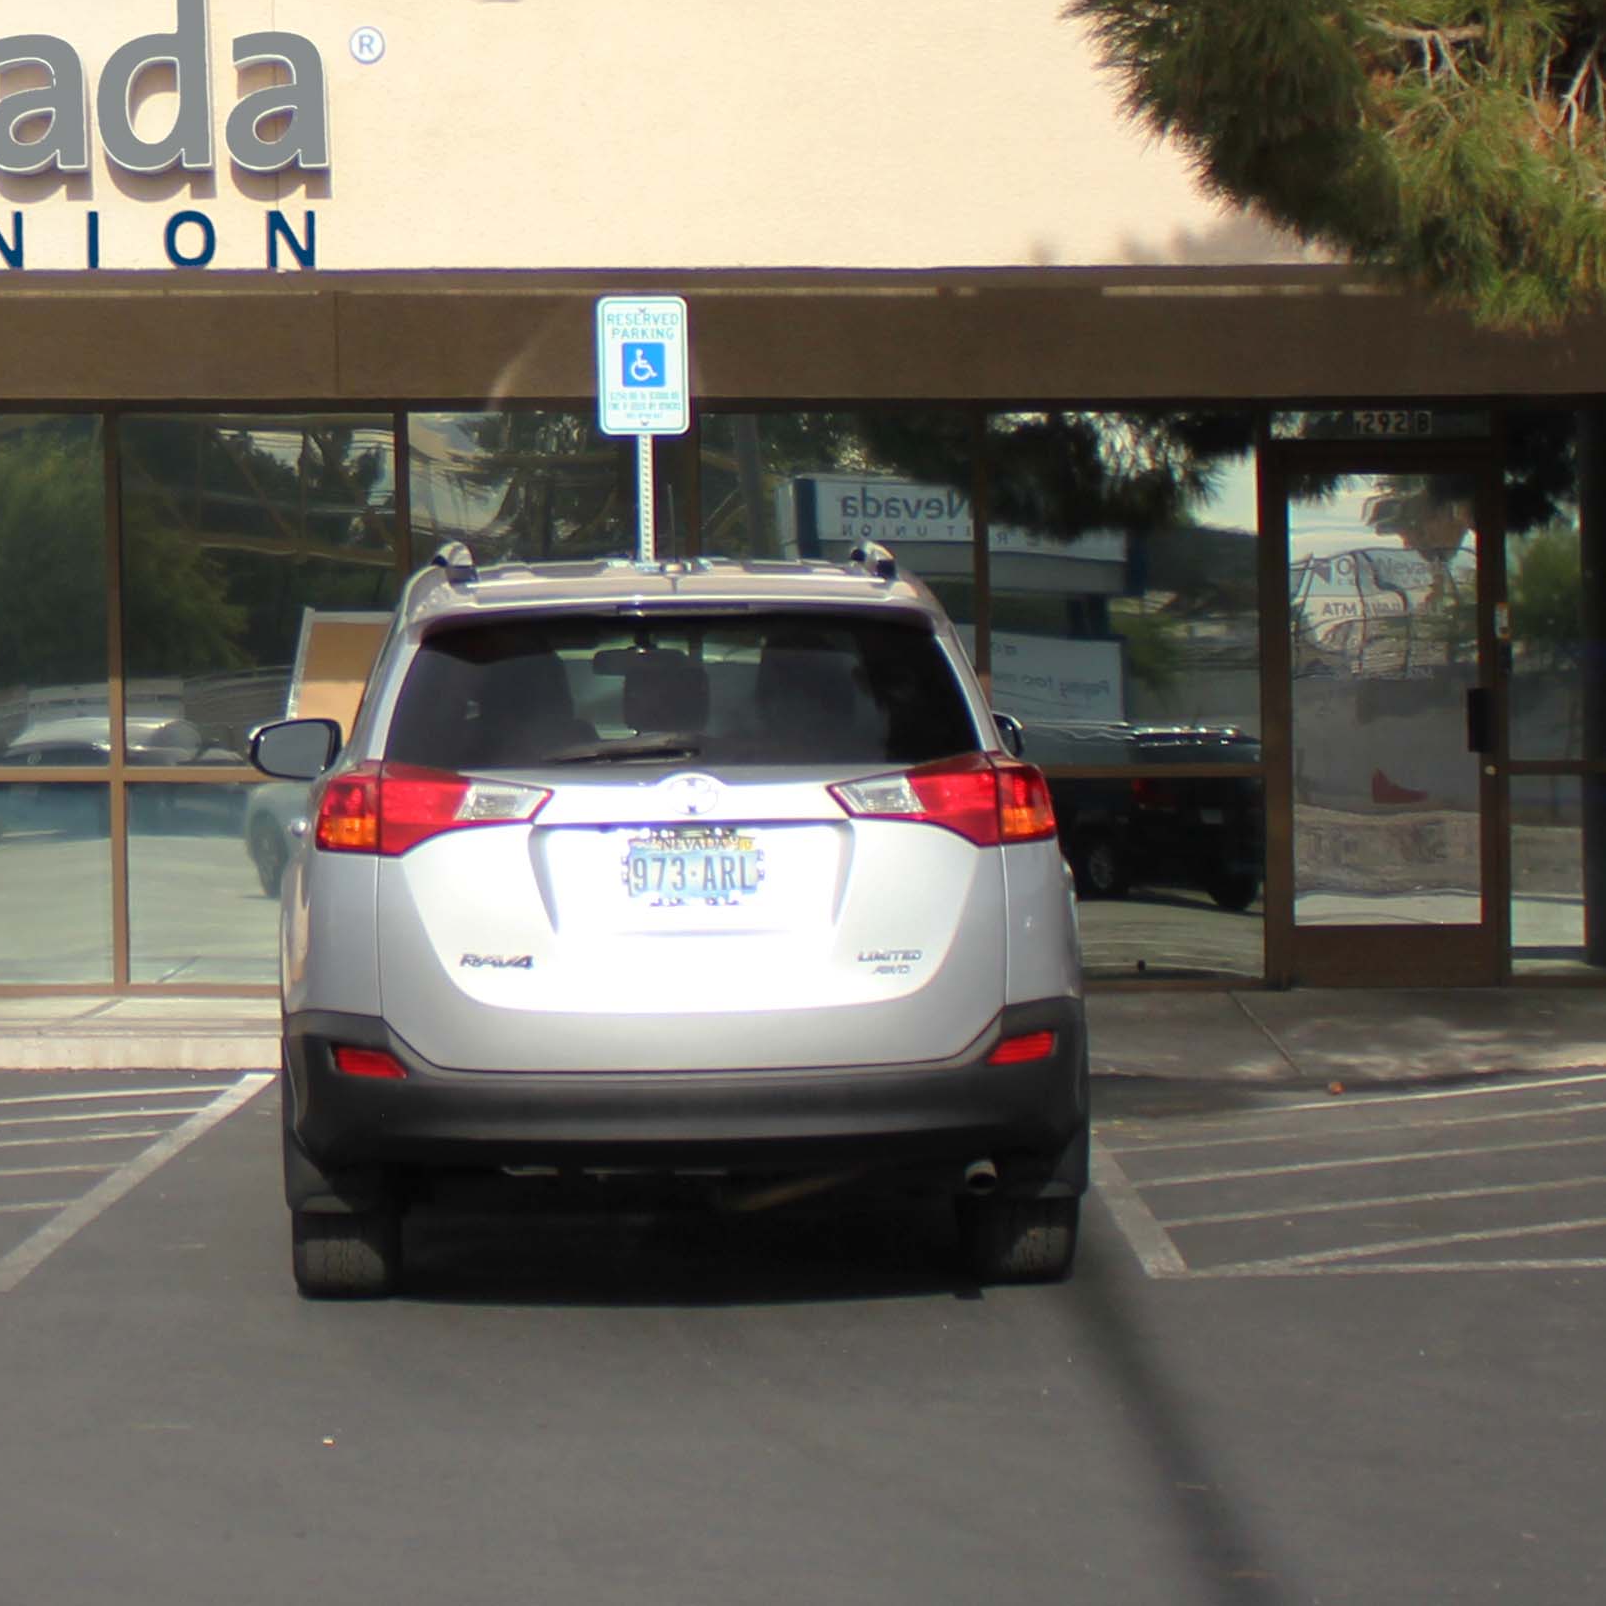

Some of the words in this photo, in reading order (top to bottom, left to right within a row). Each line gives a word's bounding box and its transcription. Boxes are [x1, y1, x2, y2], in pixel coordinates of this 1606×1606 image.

[607, 313, 679, 325] RESERVED
[612, 327, 675, 339] PARKING
[661, 838, 726, 851] NEVADA
[459, 953, 534, 970] RAV4
[857, 948, 923, 962] LIMITED
